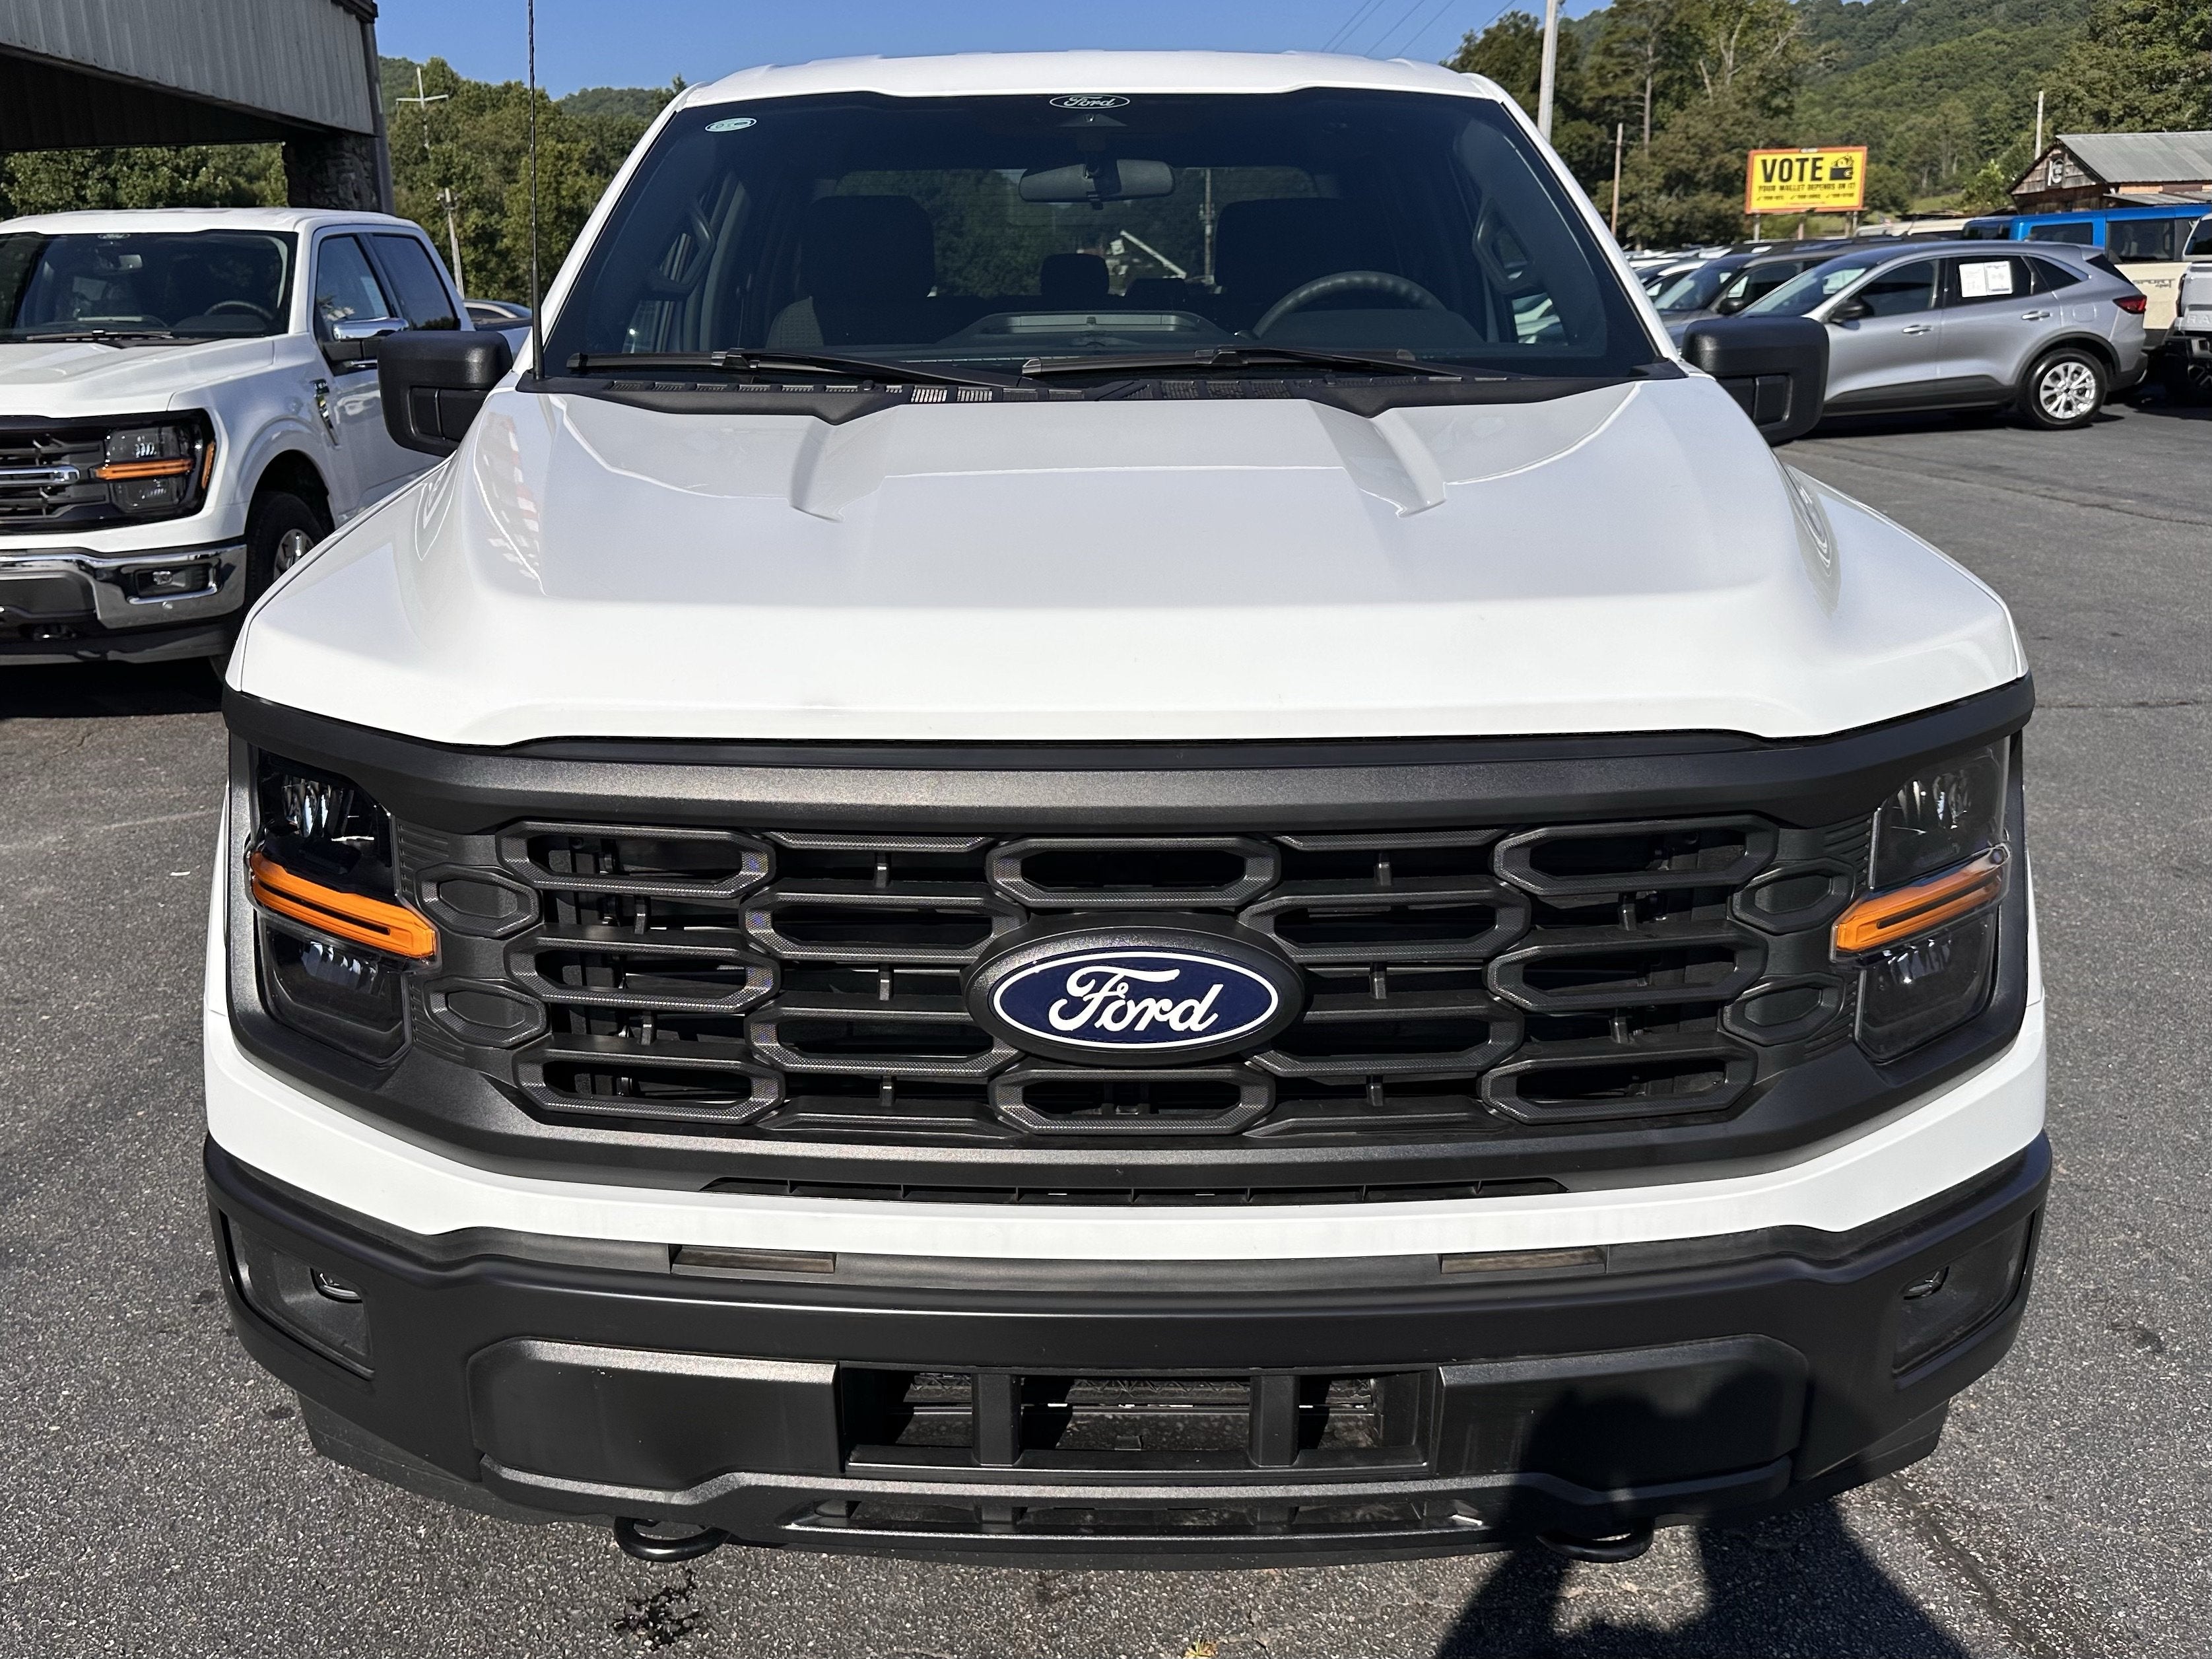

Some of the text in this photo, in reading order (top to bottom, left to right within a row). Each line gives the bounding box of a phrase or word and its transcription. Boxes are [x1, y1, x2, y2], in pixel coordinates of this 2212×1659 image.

[1063, 96, 1116, 106] Ford
[1761, 157, 1824, 182] VOTE
[1048, 965, 1224, 1032] Ford
